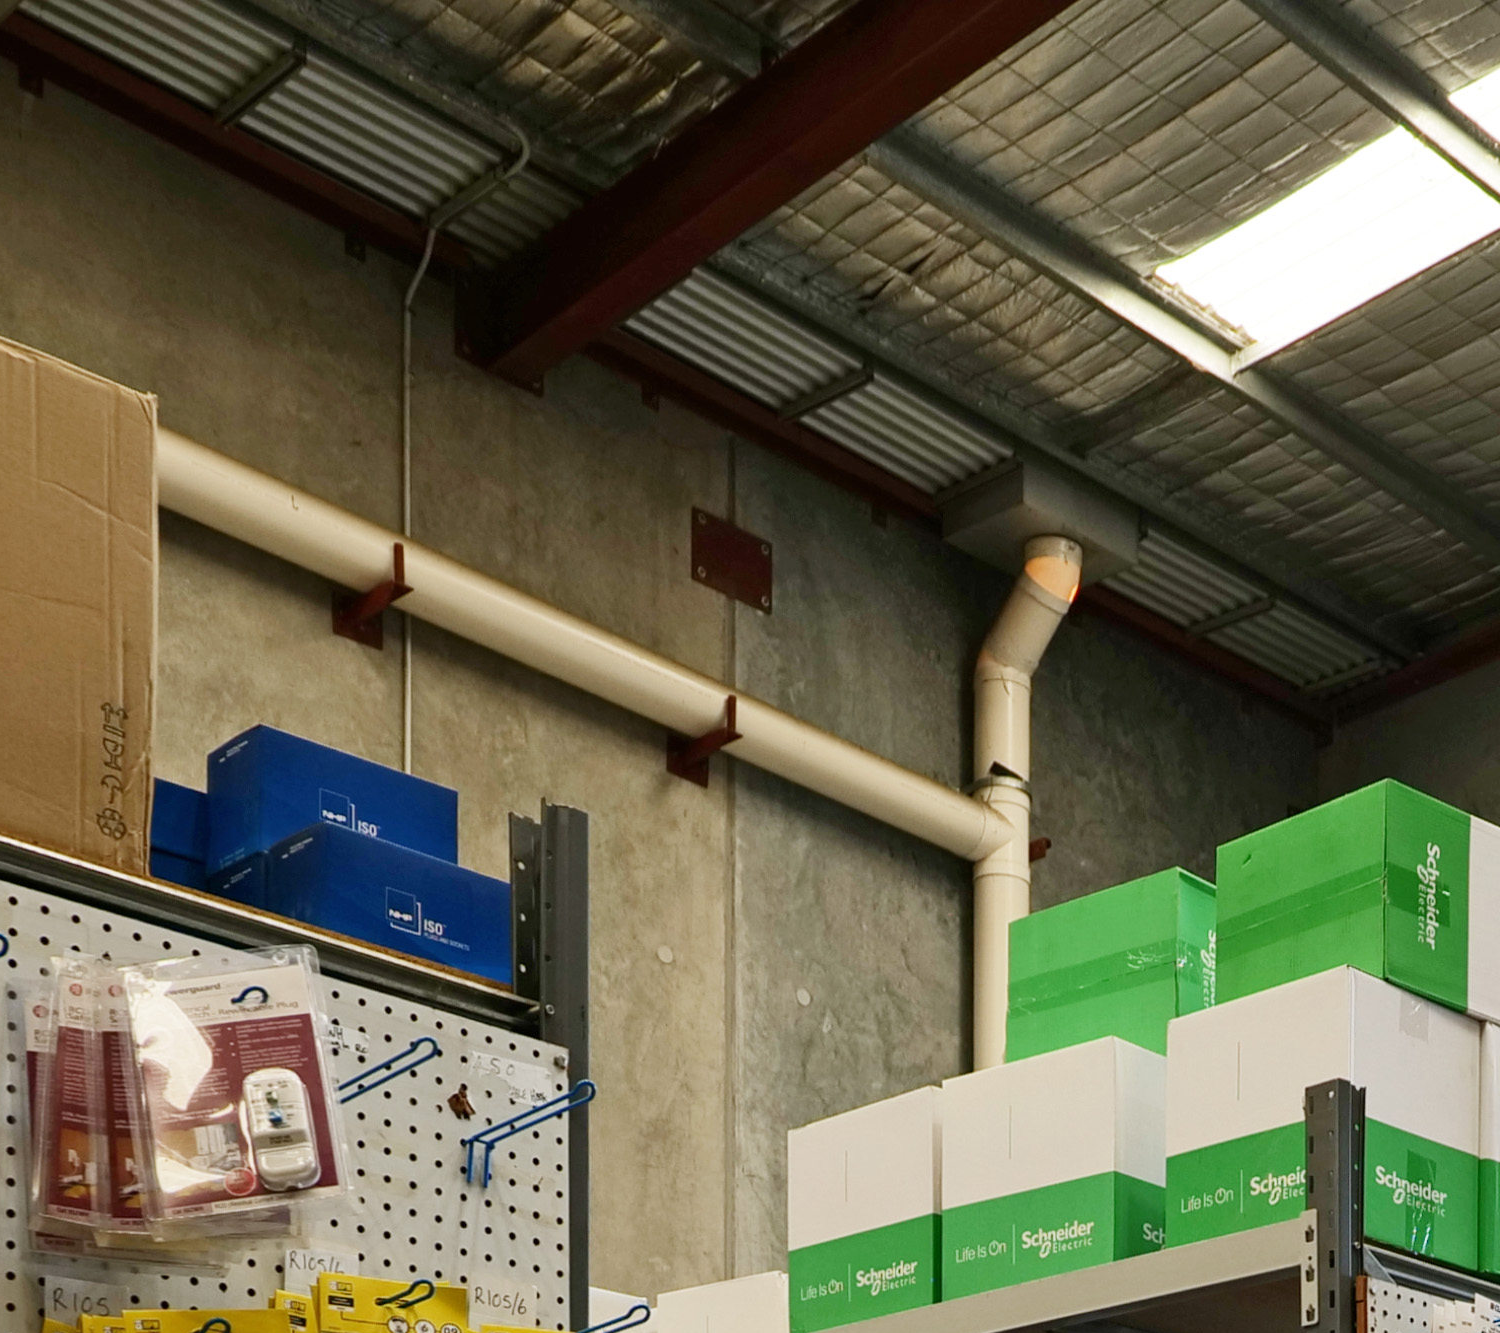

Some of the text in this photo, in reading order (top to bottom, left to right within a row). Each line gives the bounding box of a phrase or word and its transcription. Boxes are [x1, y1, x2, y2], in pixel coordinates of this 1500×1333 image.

[357, 819, 378, 838] ISO
[1426, 841, 1441, 951] Schneider
[1417, 884, 1427, 943] Electric
[423, 918, 444, 937] ISO
[1374, 1165, 1448, 1205] Schneider
[1180, 1187, 1235, 1215] Life Is On
[1405, 1197, 1447, 1219] Electric
[1021, 1219, 1095, 1250] Schneider
[1052, 1236, 1094, 1255] Electric
[955, 1240, 1006, 1264] Life Is On
[855, 1259, 919, 1288] Schneider
[881, 1273, 918, 1292] Electric
[799, 1277, 844, 1301] Life Is On
[420, 1322, 429, 1333] 6
